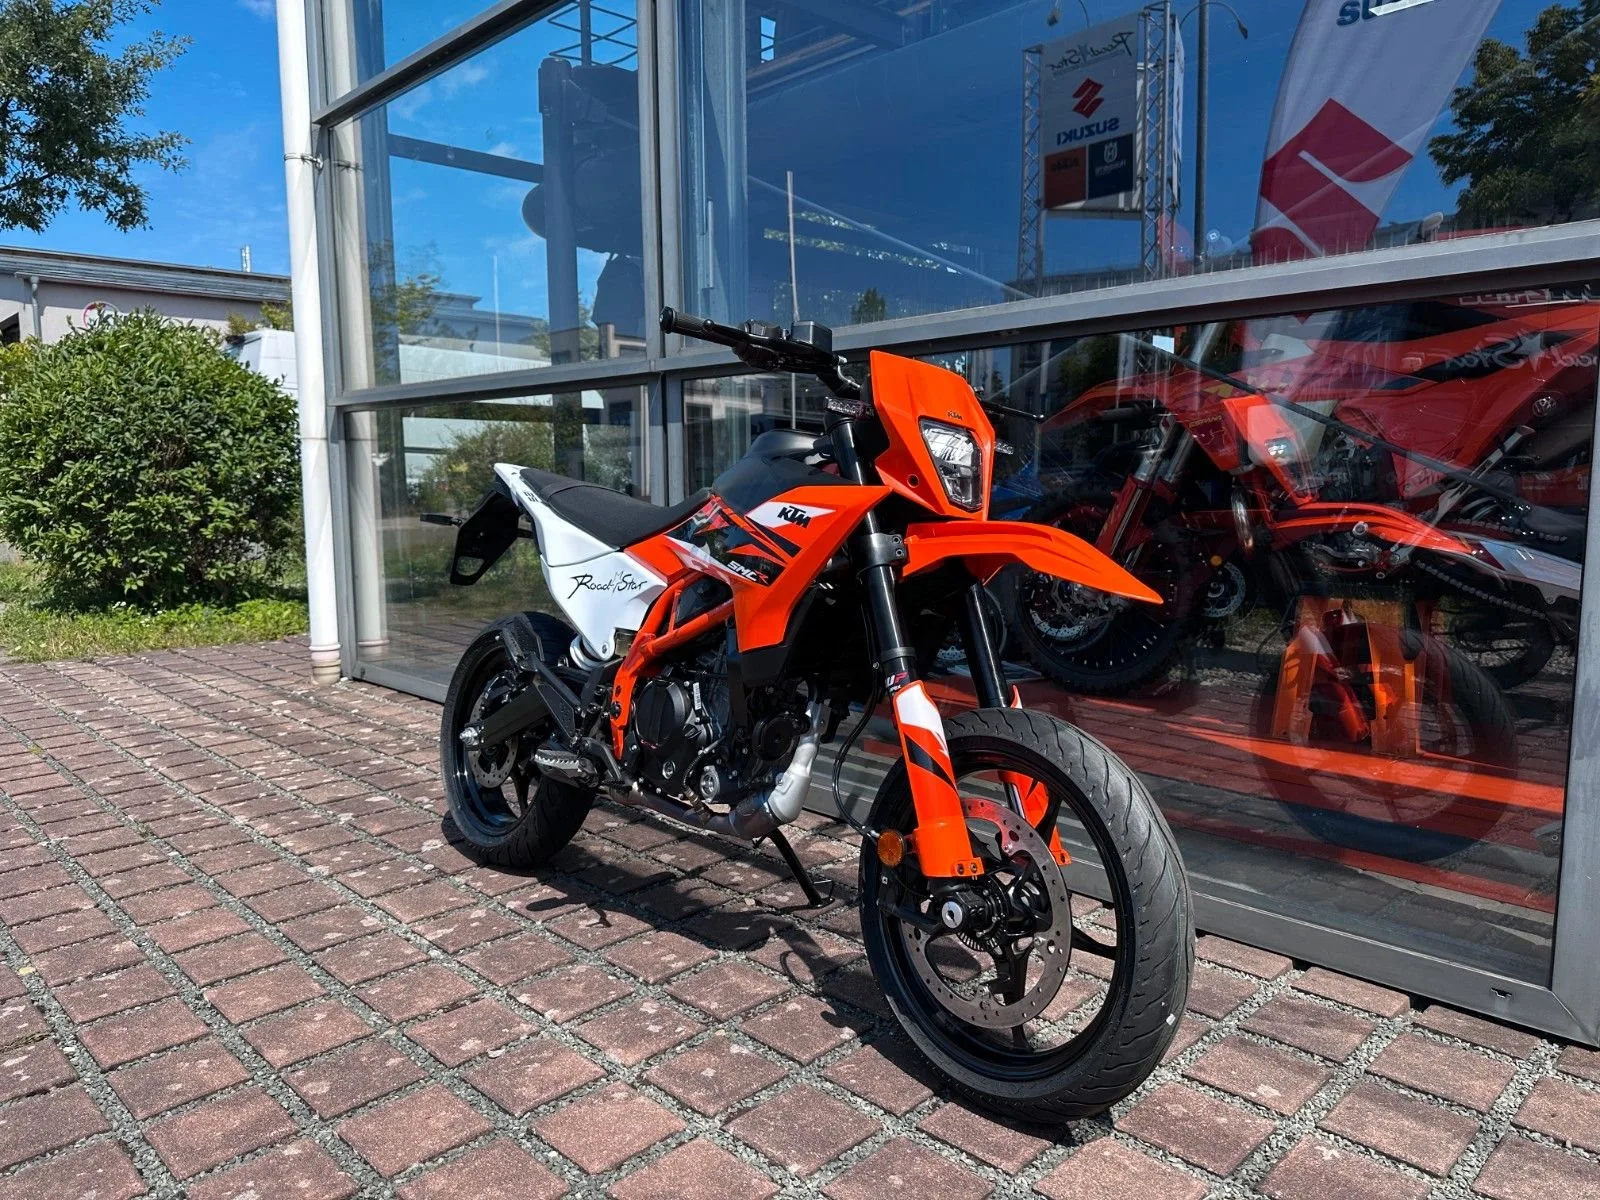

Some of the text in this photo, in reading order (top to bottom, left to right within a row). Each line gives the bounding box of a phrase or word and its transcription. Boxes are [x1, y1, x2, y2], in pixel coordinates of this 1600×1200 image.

[777, 505, 812, 529] KTM
[567, 572, 648, 600] Road Star
